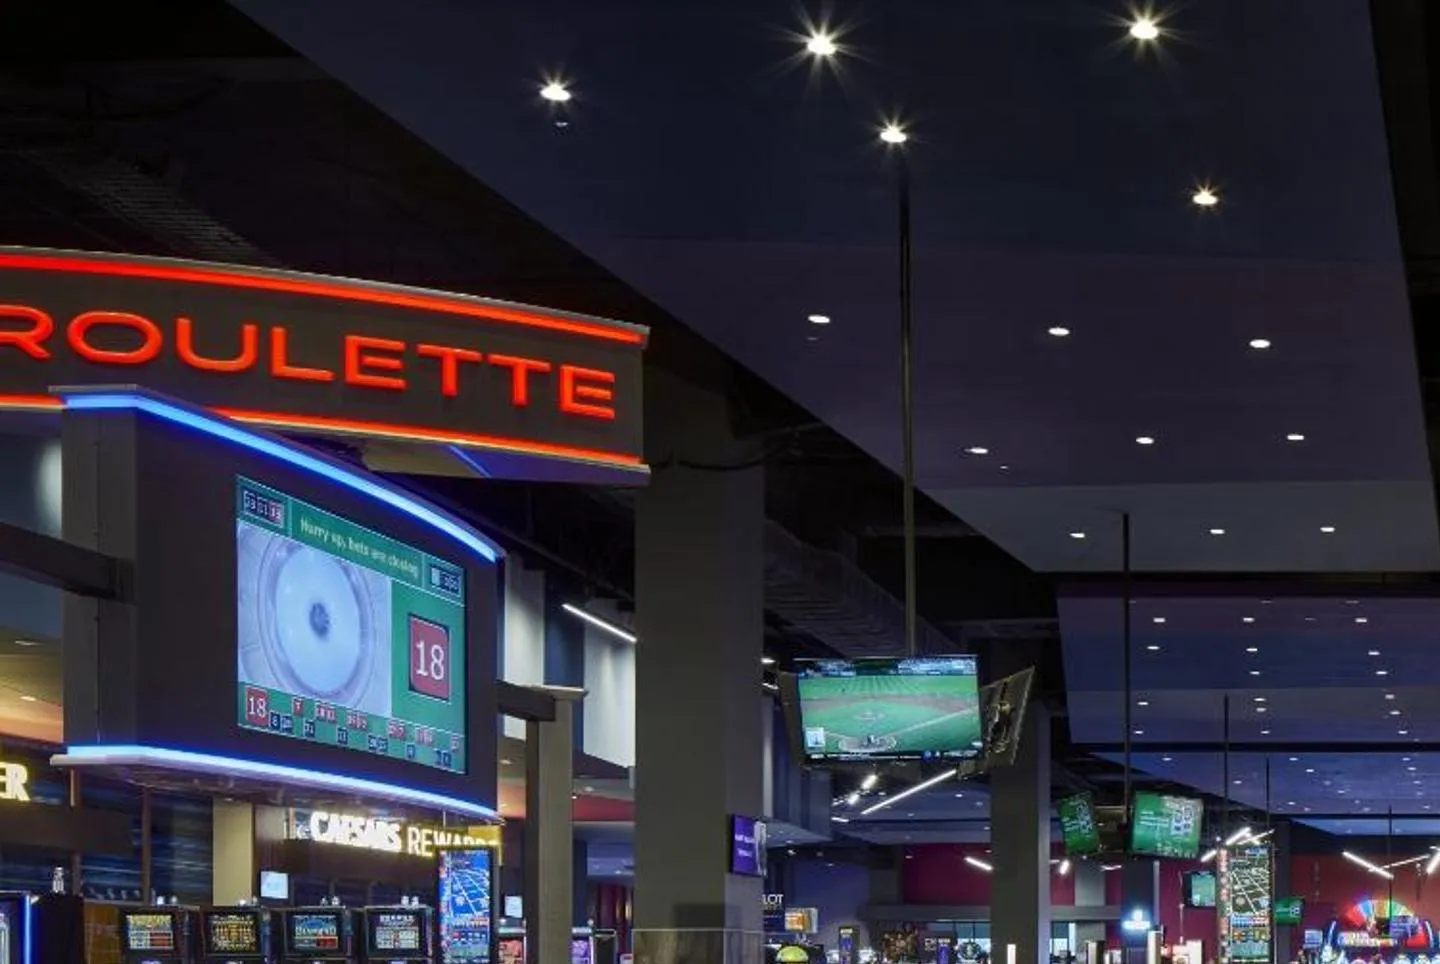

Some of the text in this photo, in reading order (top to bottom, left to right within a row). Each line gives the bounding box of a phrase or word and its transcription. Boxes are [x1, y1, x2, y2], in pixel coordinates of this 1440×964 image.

[0, 304, 616, 420] ROULETTE
[416, 640, 445, 680] 18
[248, 696, 267, 719] 18
[762, 894, 784, 905] LOT
